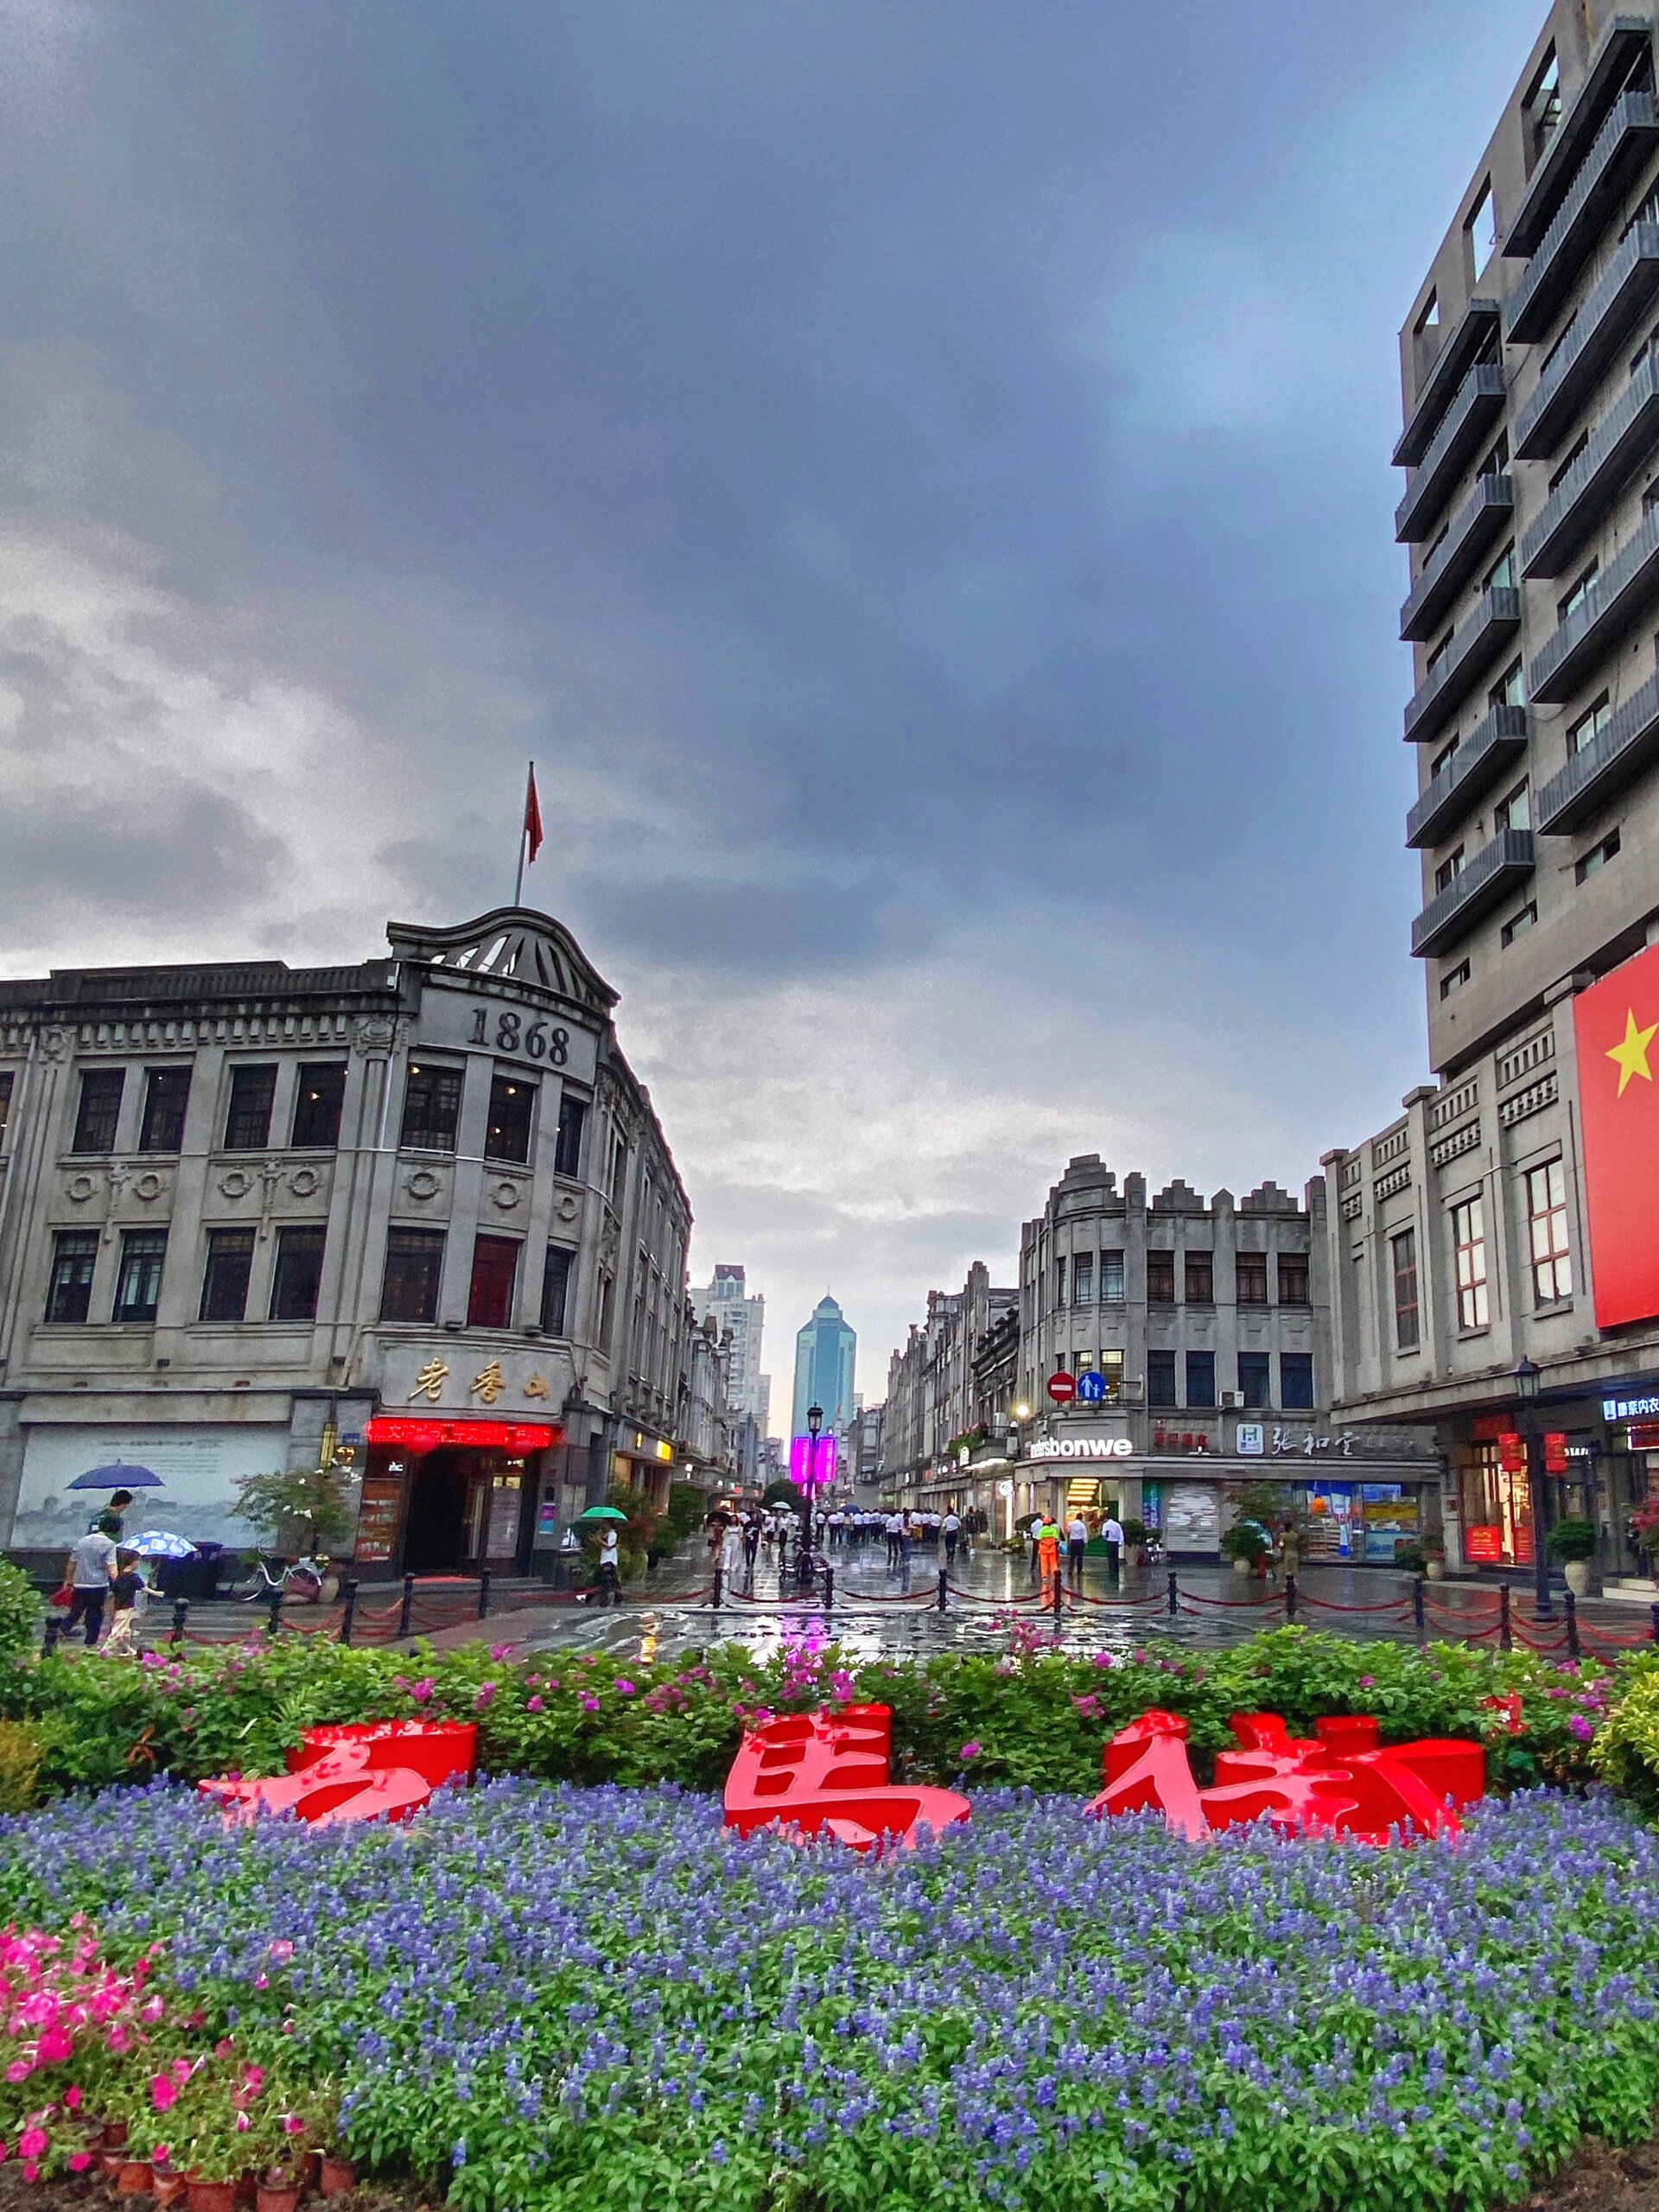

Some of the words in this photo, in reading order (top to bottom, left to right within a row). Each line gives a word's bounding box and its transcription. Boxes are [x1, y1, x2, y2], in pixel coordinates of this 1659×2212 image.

[467, 1007, 569, 1066] 1868
[407, 1357, 550, 1405] 老香山
